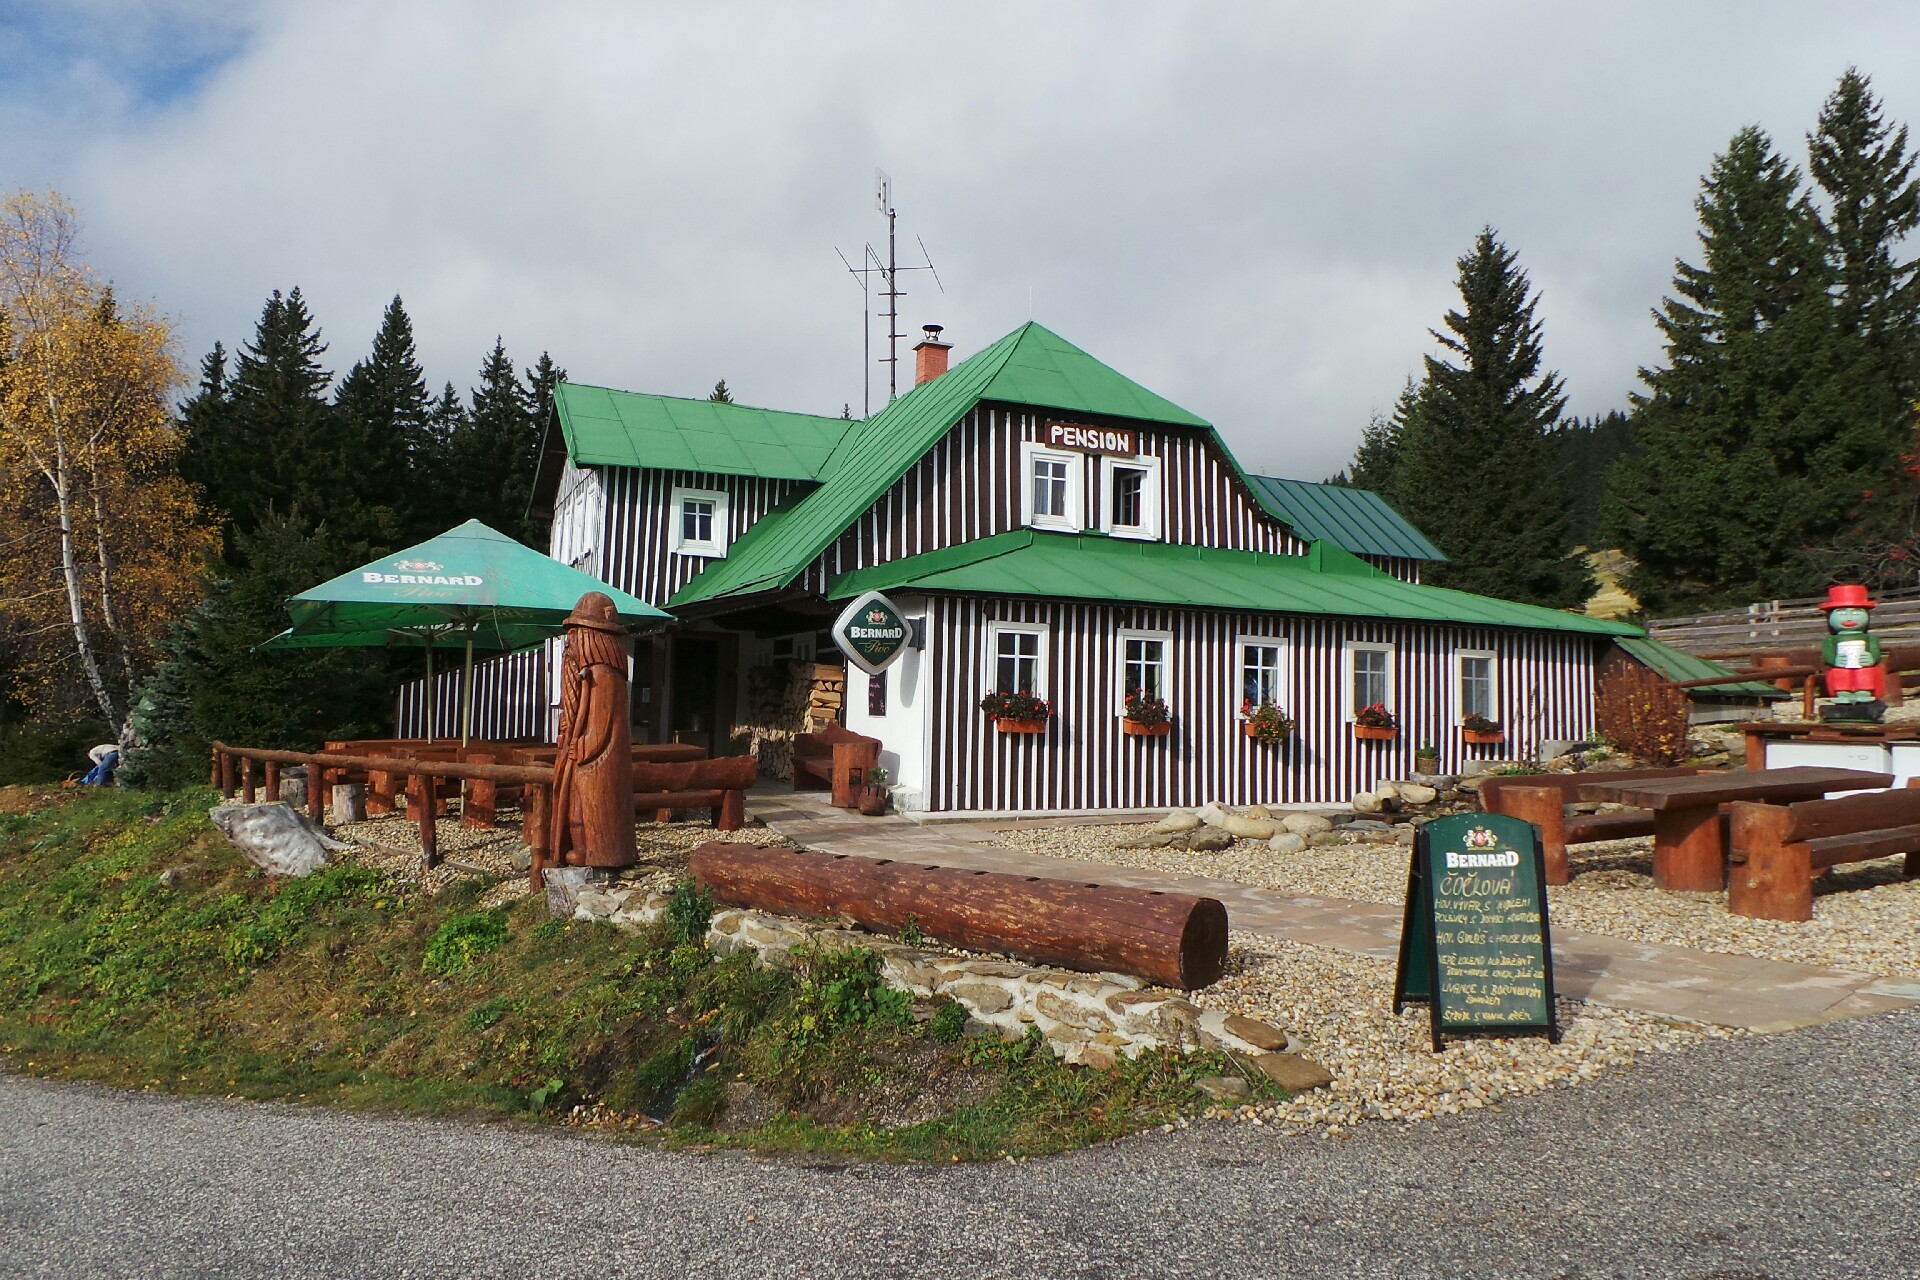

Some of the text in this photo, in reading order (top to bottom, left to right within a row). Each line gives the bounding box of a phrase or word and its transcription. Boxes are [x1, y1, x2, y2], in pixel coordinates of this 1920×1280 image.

[1051, 425, 1129, 453] PENSION
[363, 572, 483, 586] BERNARD
[850, 626, 903, 639] BERNARD
[864, 640, 890, 653] Pivo
[1445, 850, 1519, 868] BERNARD
[1483, 900, 1491, 911] S
[1469, 915, 1477, 924] S
[1481, 984, 1488, 994] S
[1473, 1011, 1480, 1021] S
